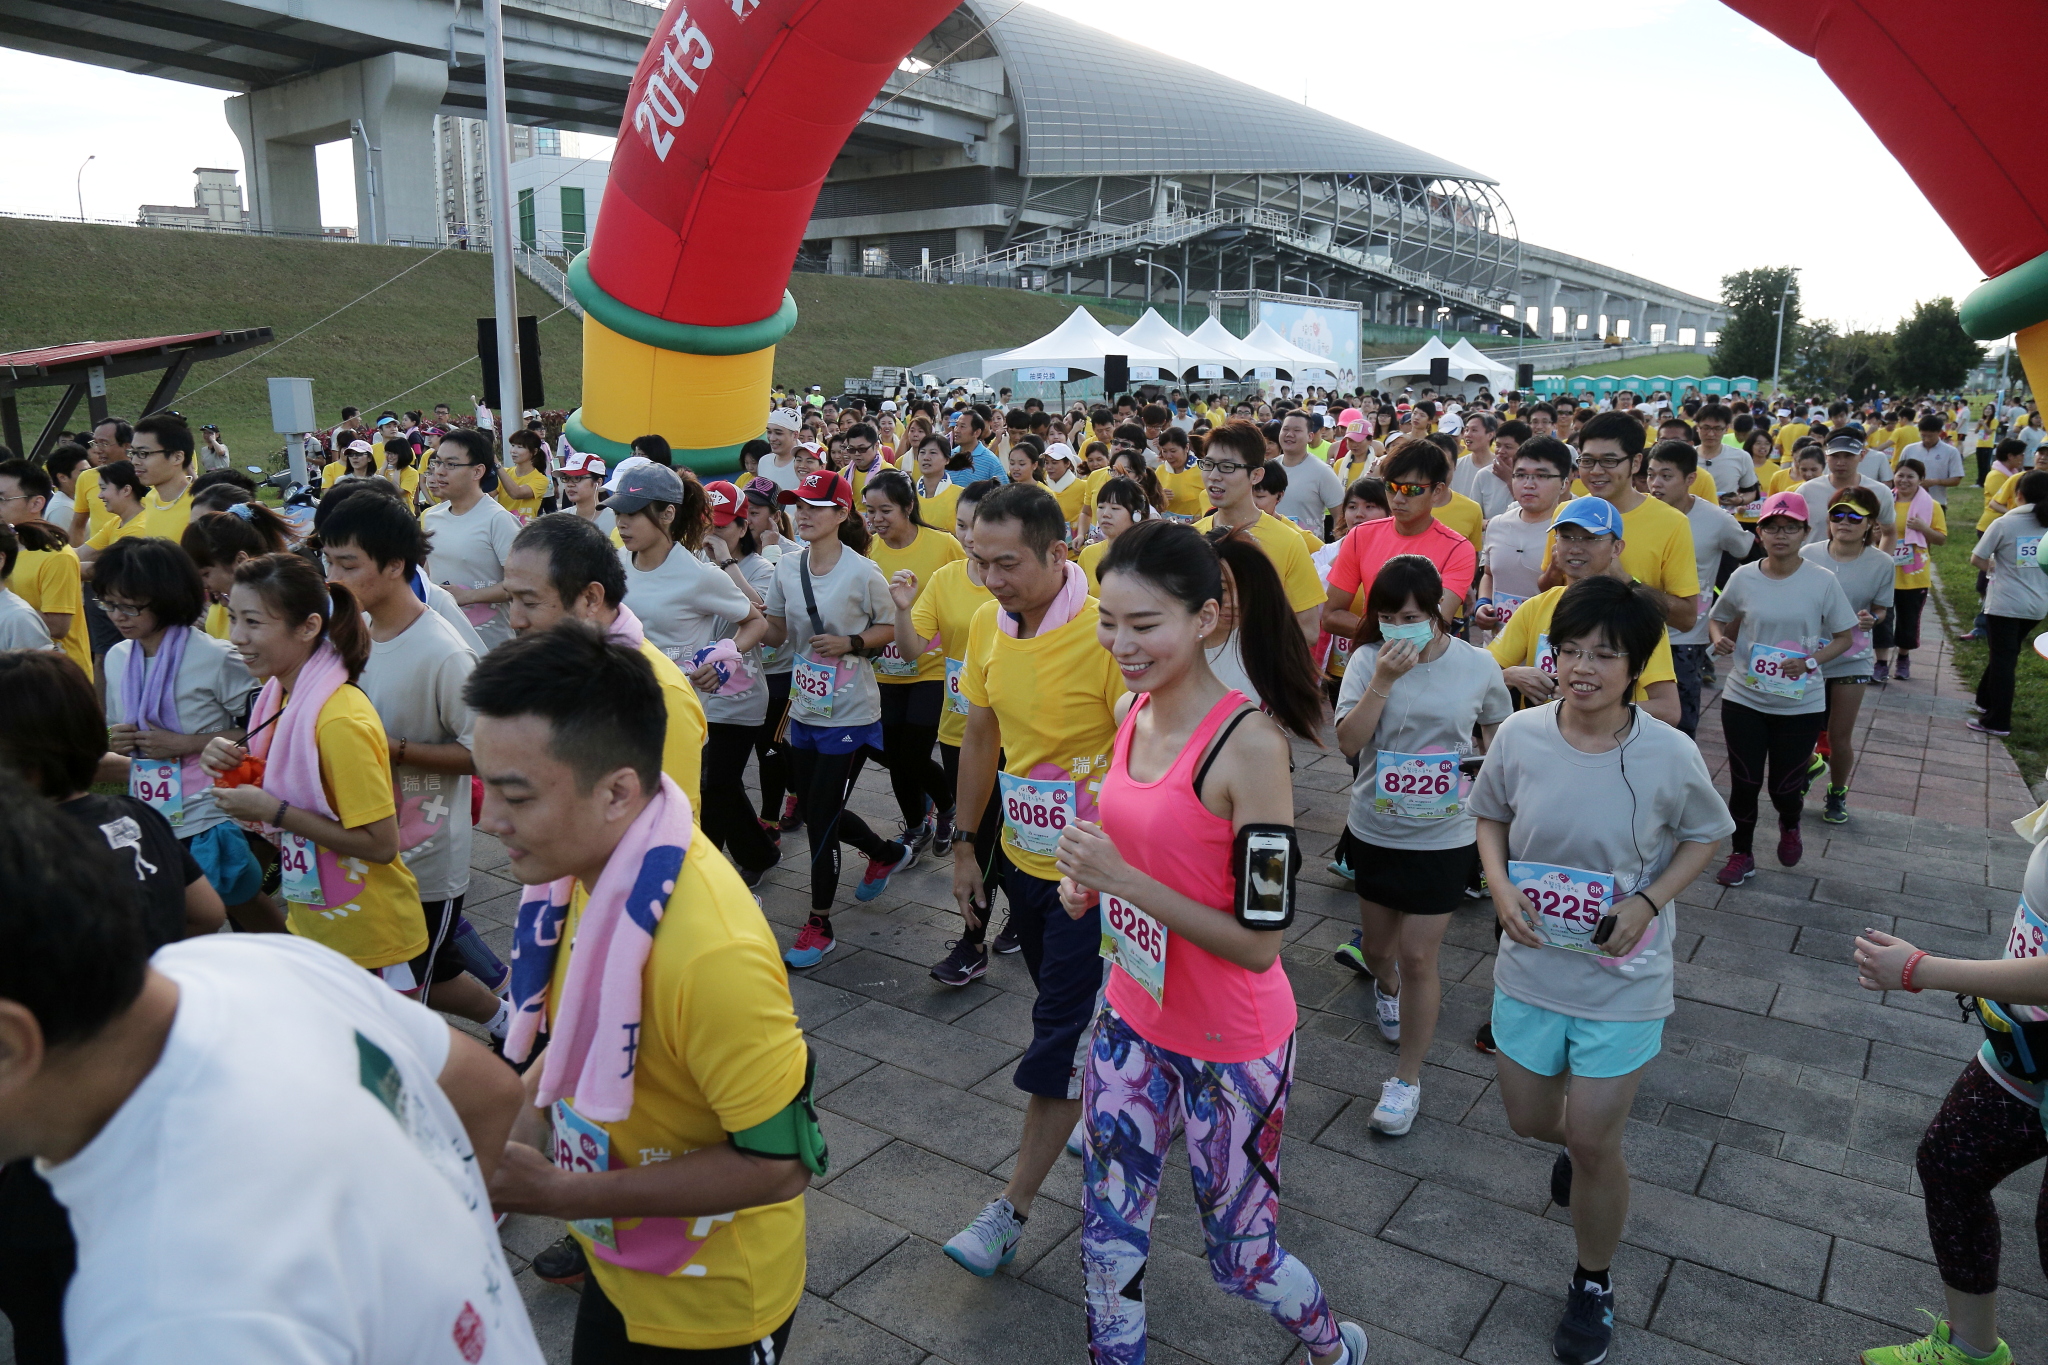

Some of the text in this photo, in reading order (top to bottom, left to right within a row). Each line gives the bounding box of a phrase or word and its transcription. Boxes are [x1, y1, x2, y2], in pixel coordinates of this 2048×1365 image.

[635, 8, 713, 162] 2015
[1893, 547, 1909, 557] 72
[2021, 546, 2037, 556] 53
[1497, 607, 1512, 623] 82
[795, 669, 827, 697] 8323
[1072, 754, 1108, 774] 瑞信
[133, 780, 172, 801] 94
[402, 773, 441, 792] 瑞信
[1384, 772, 1450, 795] 8226
[1055, 792, 1066, 801] 8K
[1008, 797, 1067, 830] 8086
[1590, 885, 1602, 894] 8K
[1522, 888, 1600, 925] 8225
[1109, 897, 1162, 963] 8285
